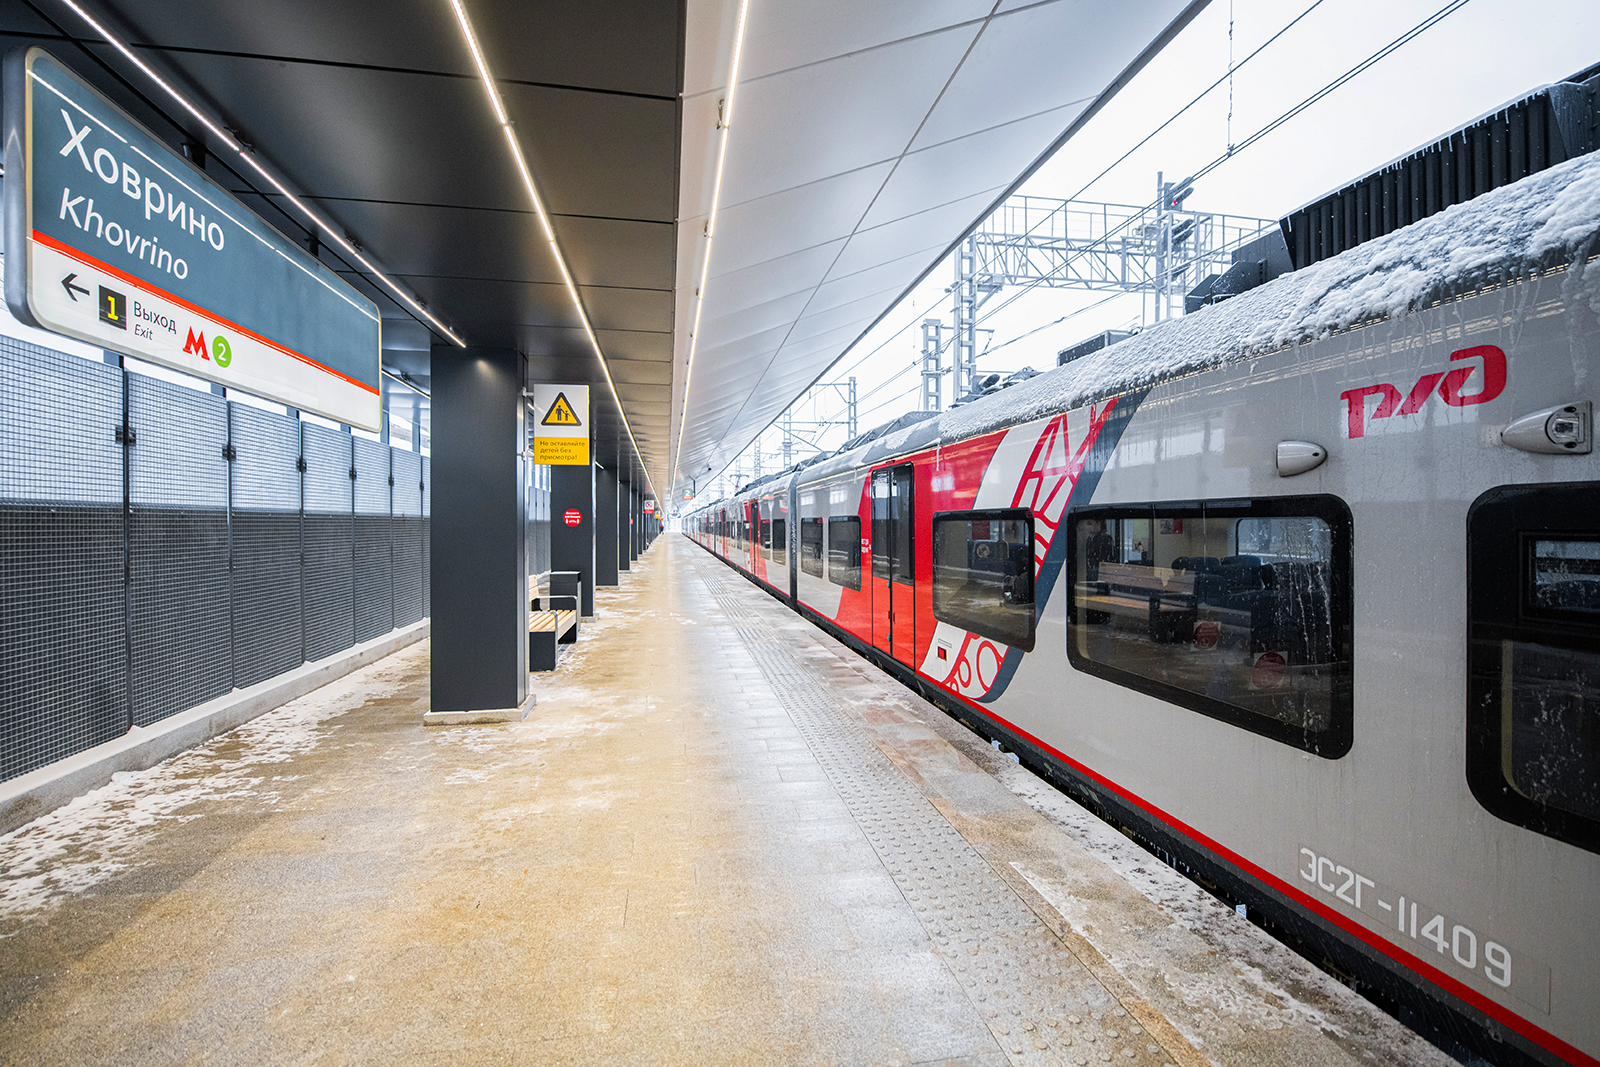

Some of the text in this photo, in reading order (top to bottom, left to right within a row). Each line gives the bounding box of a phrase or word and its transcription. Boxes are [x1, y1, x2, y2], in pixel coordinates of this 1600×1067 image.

[59, 108, 225, 251] Ховрино
[59, 187, 188, 280] Khovrino
[107, 295, 119, 321] 1
[134, 300, 177, 335] Выход
[134, 323, 153, 341] Exit
[217, 342, 227, 362] 2
[1340, 344, 1507, 439] РЖД
